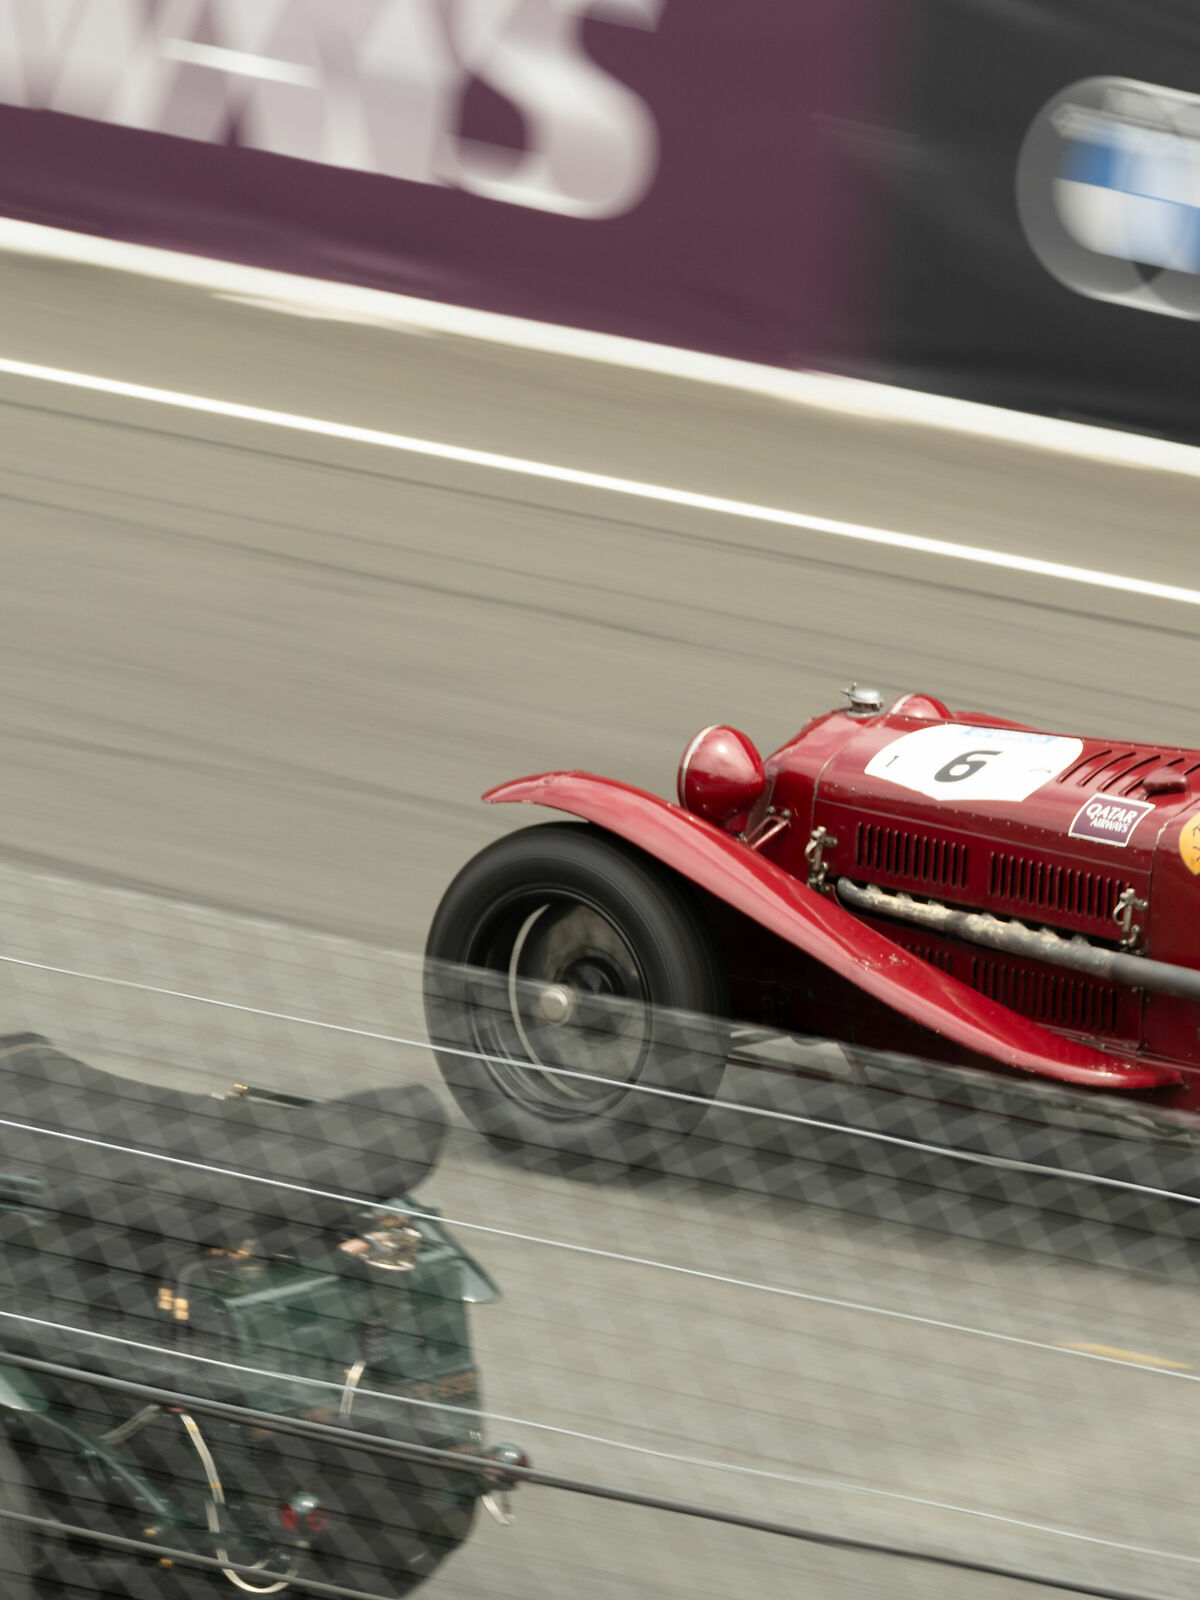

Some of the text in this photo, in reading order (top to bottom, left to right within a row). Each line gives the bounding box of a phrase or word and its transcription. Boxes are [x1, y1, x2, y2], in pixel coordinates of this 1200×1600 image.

[934, 750, 1003, 783] 6
[1086, 803, 1138, 824] QATAR
[1089, 818, 1129, 833] AIRWAYS
